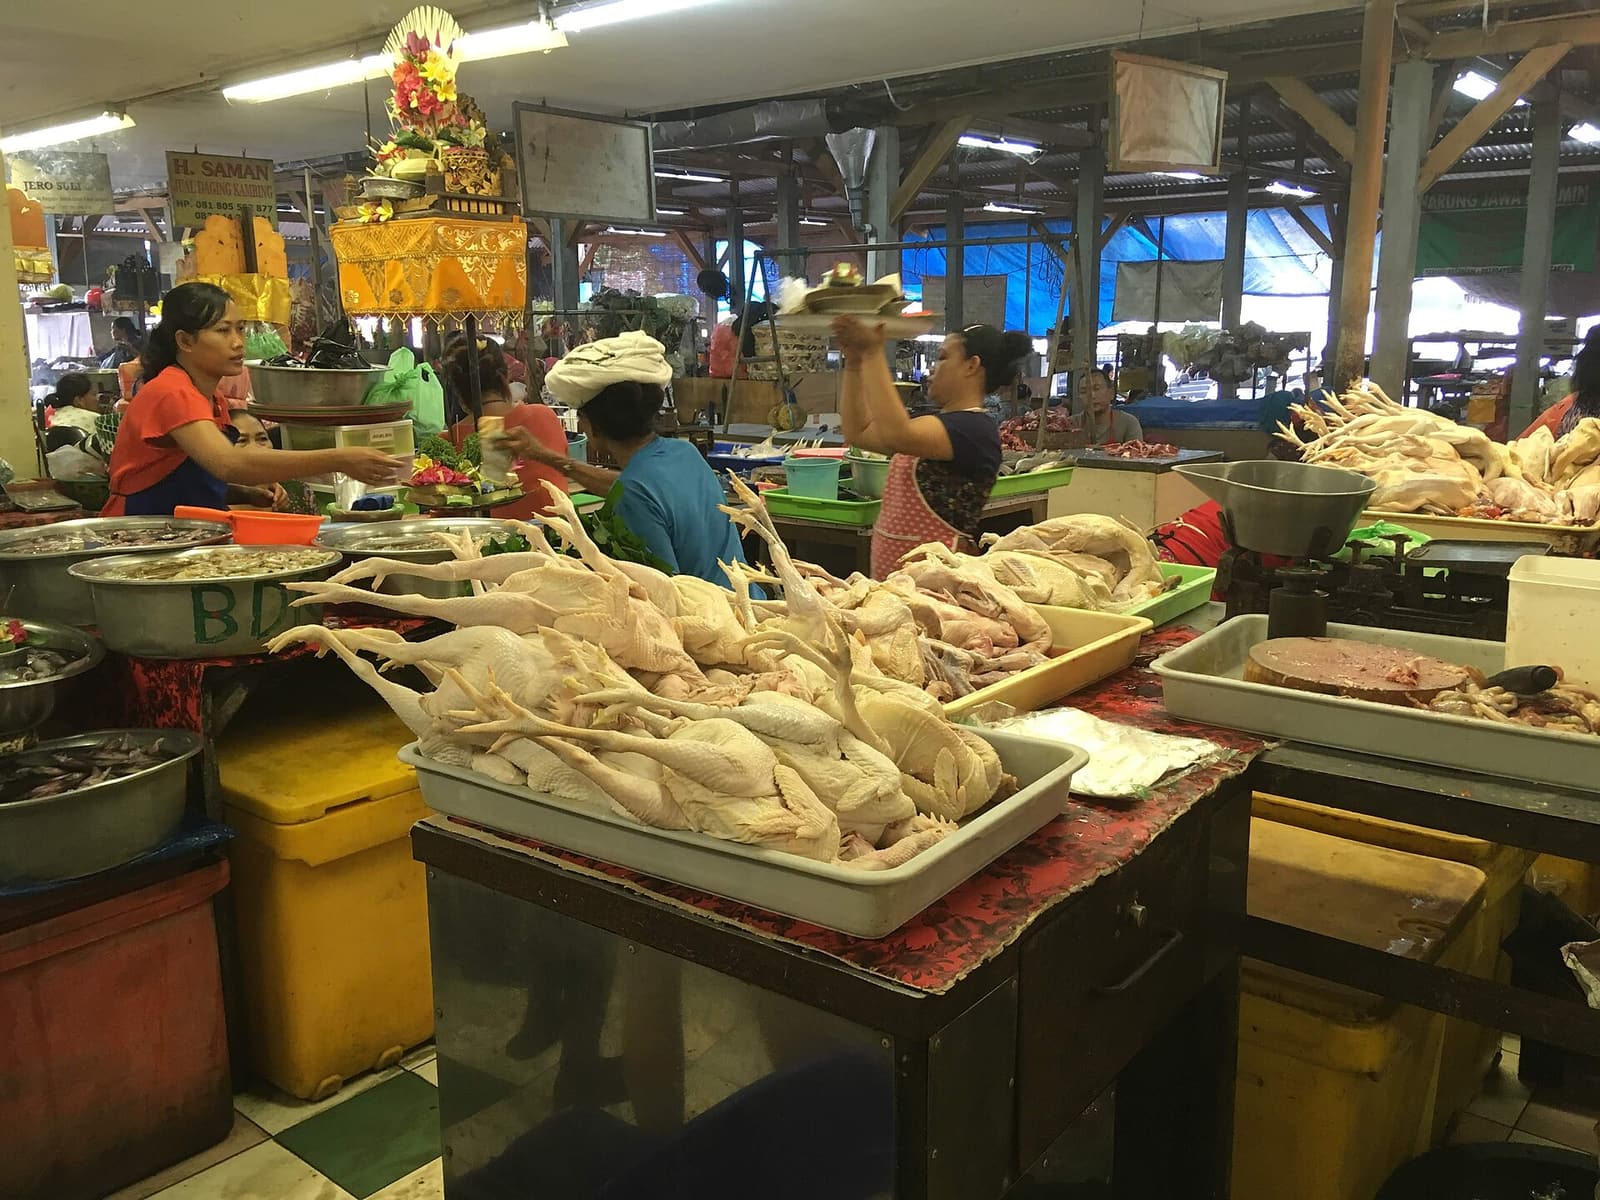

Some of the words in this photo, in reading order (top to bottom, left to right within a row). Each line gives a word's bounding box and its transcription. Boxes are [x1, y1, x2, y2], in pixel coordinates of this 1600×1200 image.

[173, 158, 195, 176] H.
[201, 160, 269, 181] SAMAN
[23, 181, 54, 192] JERO
[233, 182, 273, 199] KAMBING
